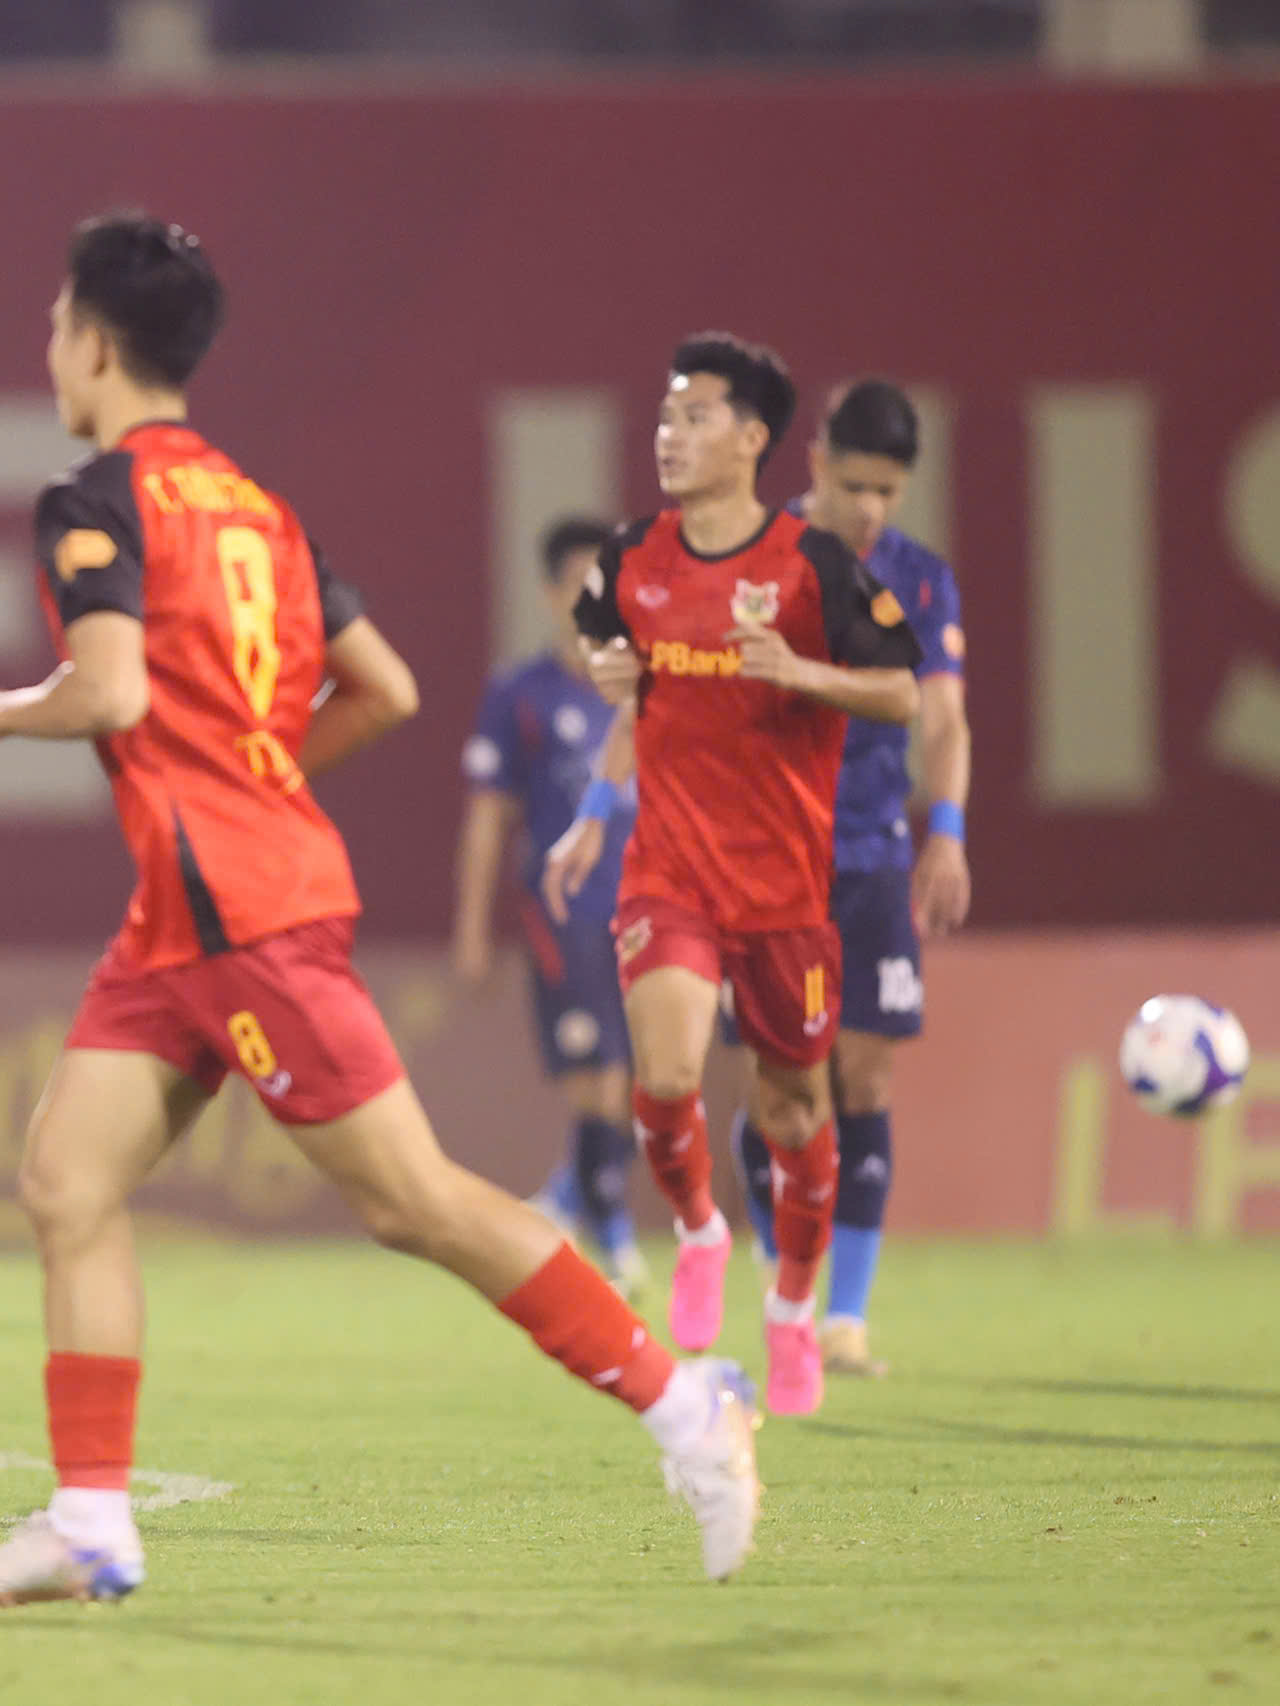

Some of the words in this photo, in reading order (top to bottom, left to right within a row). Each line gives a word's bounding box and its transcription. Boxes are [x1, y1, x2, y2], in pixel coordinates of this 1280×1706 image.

[216, 527, 281, 719] 8
[651, 640, 743, 676] PBank
[226, 1010, 278, 1079] 8
